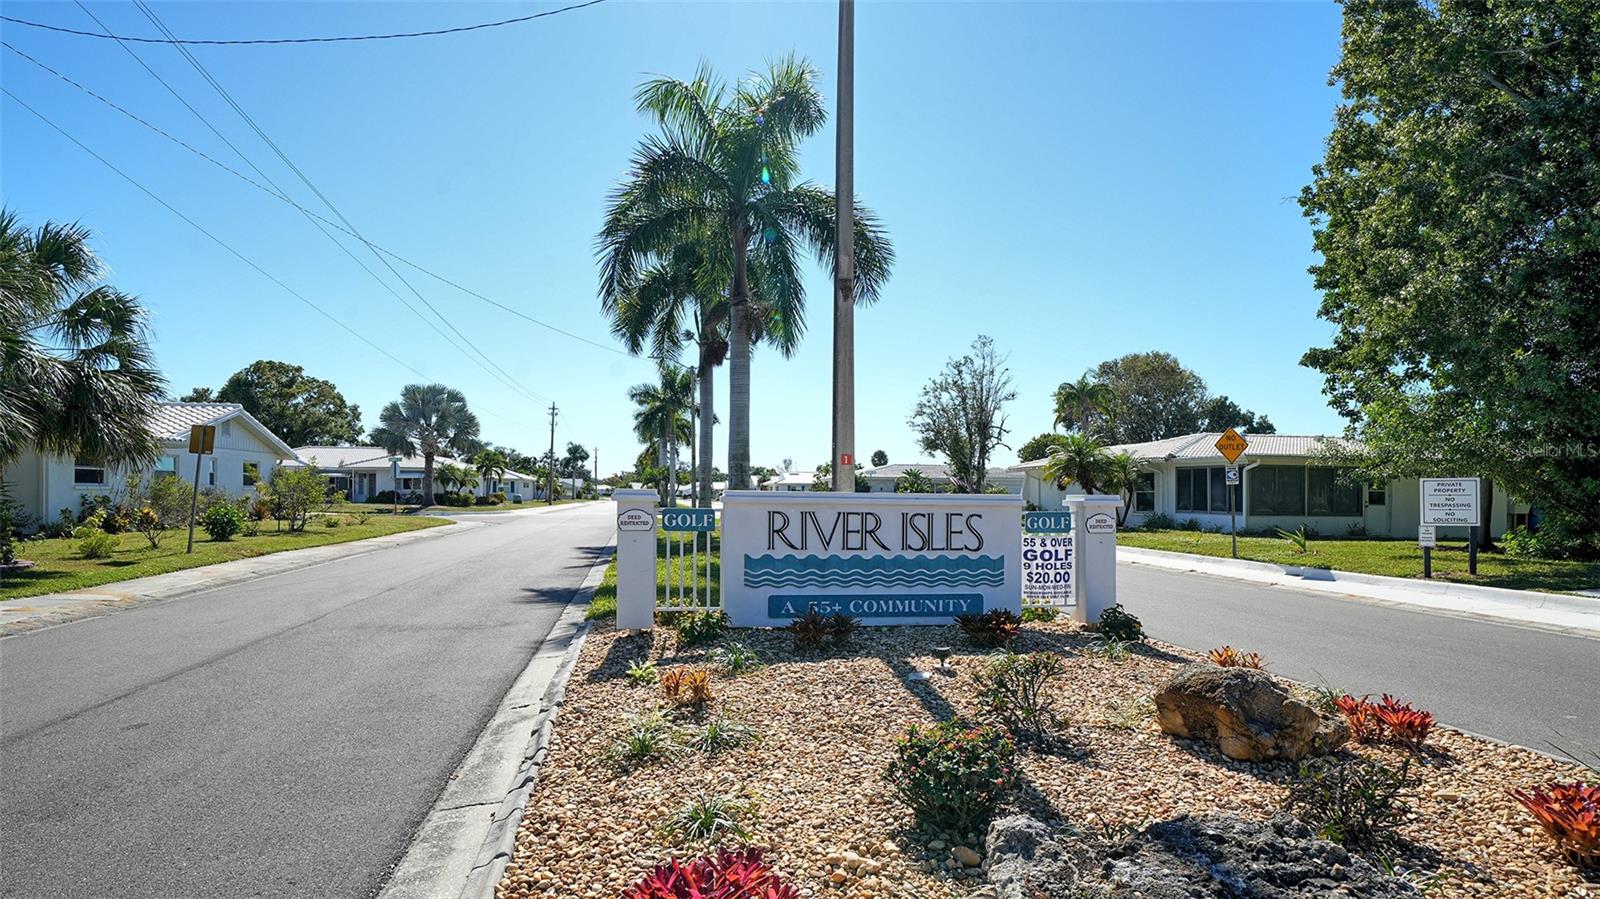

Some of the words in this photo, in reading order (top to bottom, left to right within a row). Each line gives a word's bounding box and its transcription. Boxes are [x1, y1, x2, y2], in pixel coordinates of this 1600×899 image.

[664, 514, 714, 527] GOLF
[1026, 516, 1070, 528] GOLF
[767, 511, 892, 551] RIVER
[901, 512, 985, 551] ISLES
[1023, 538, 1036, 548] 55
[1040, 538, 1047, 548] &
[1050, 538, 1072, 548] OVER
[1022, 549, 1072, 562] GOLF
[1023, 562, 1031, 570] 9
[1036, 562, 1072, 570] HOLES
[1026, 571, 1070, 584] $20.00
[781, 600, 796, 614] A
[808, 601, 842, 614] 55+
[850, 600, 972, 614] COMMUNITY
